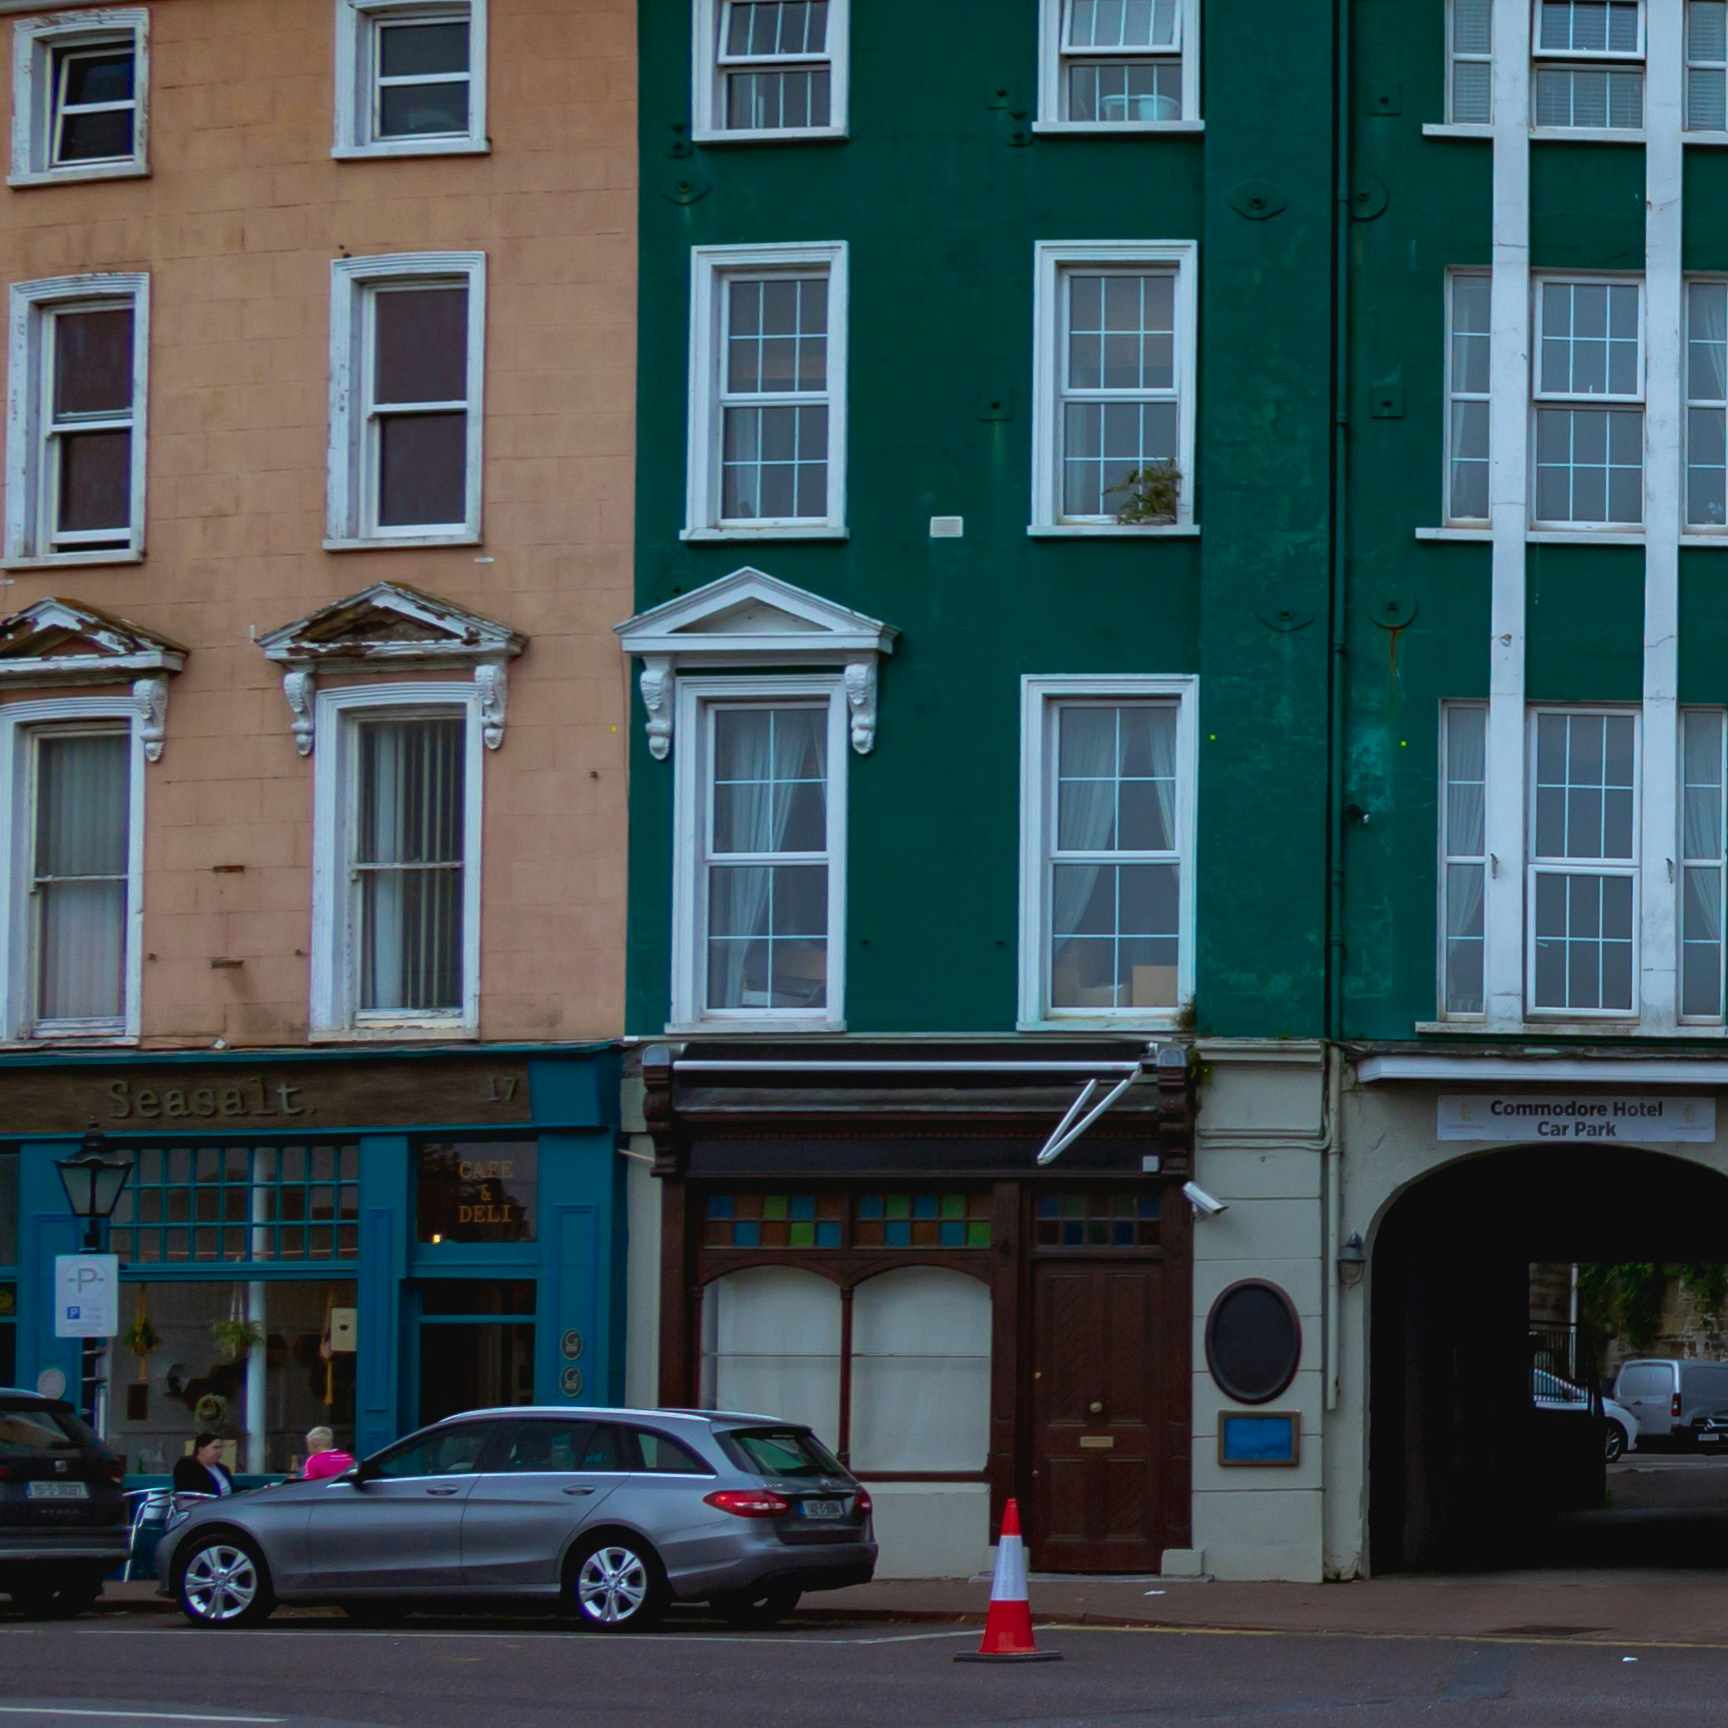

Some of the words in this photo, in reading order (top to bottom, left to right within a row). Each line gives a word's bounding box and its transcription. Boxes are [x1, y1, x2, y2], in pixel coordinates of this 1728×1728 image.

[487, 1076, 518, 1104] 17
[1490, 1100, 1607, 1116] Commodore
[1613, 1101, 1663, 1117] Hotel
[1537, 1121, 1570, 1137] Car
[1574, 1122, 1616, 1137] Park
[458, 1160, 512, 1178] CAFE
[480, 1184, 492, 1201] &
[458, 1204, 512, 1223] DELI
